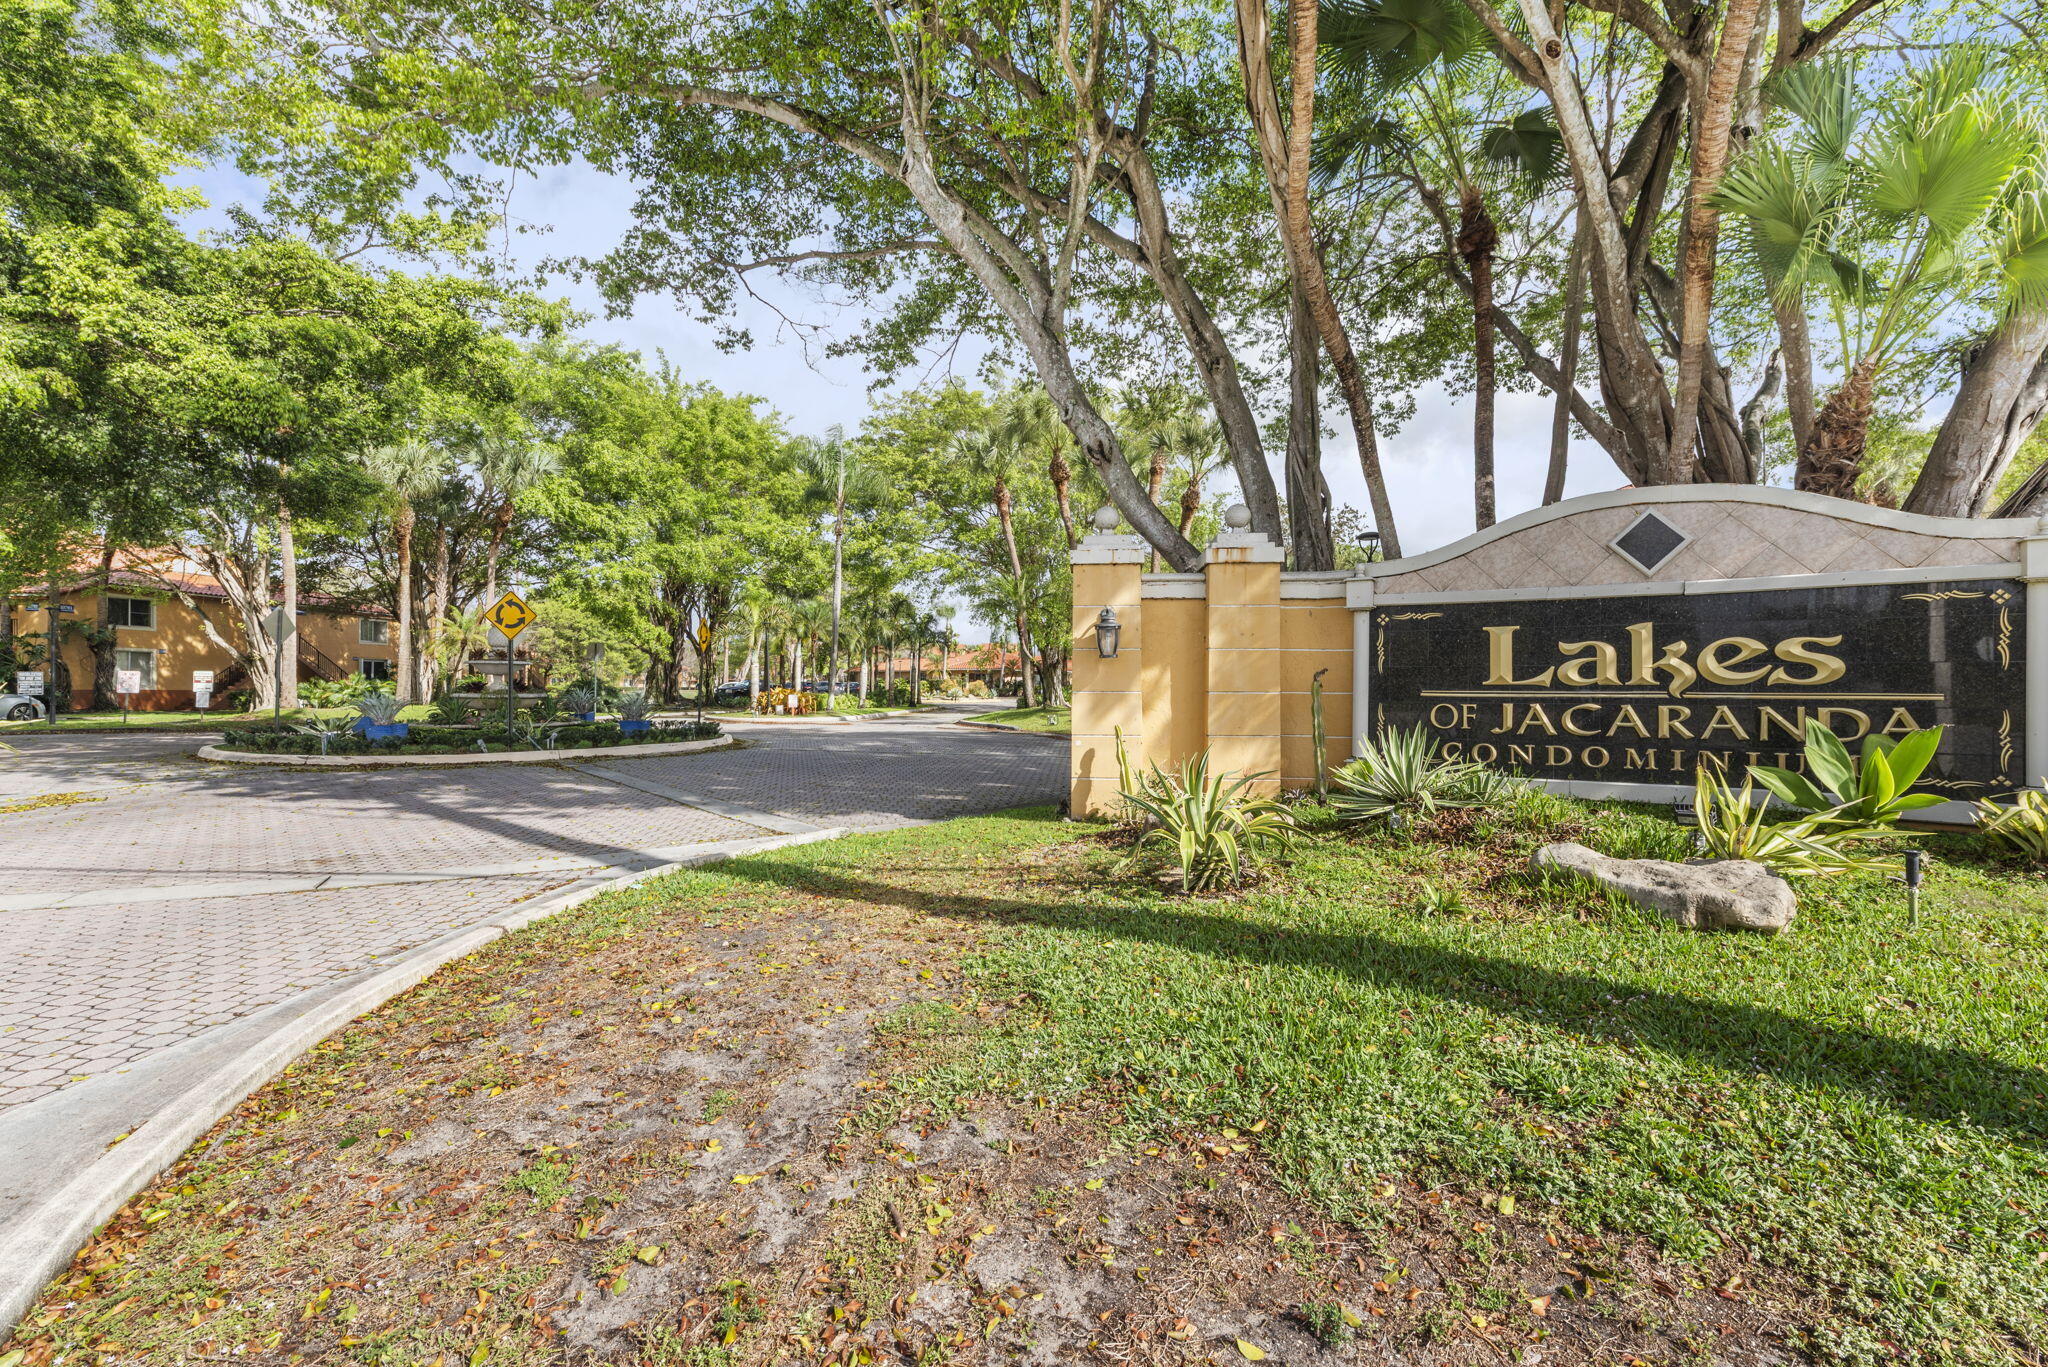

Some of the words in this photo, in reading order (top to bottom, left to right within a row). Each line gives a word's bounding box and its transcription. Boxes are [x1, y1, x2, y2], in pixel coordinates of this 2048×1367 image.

[1482, 622, 1846, 698] Lakes
[1430, 703, 1477, 729] OF
[1491, 703, 1921, 742] JACARANDA
